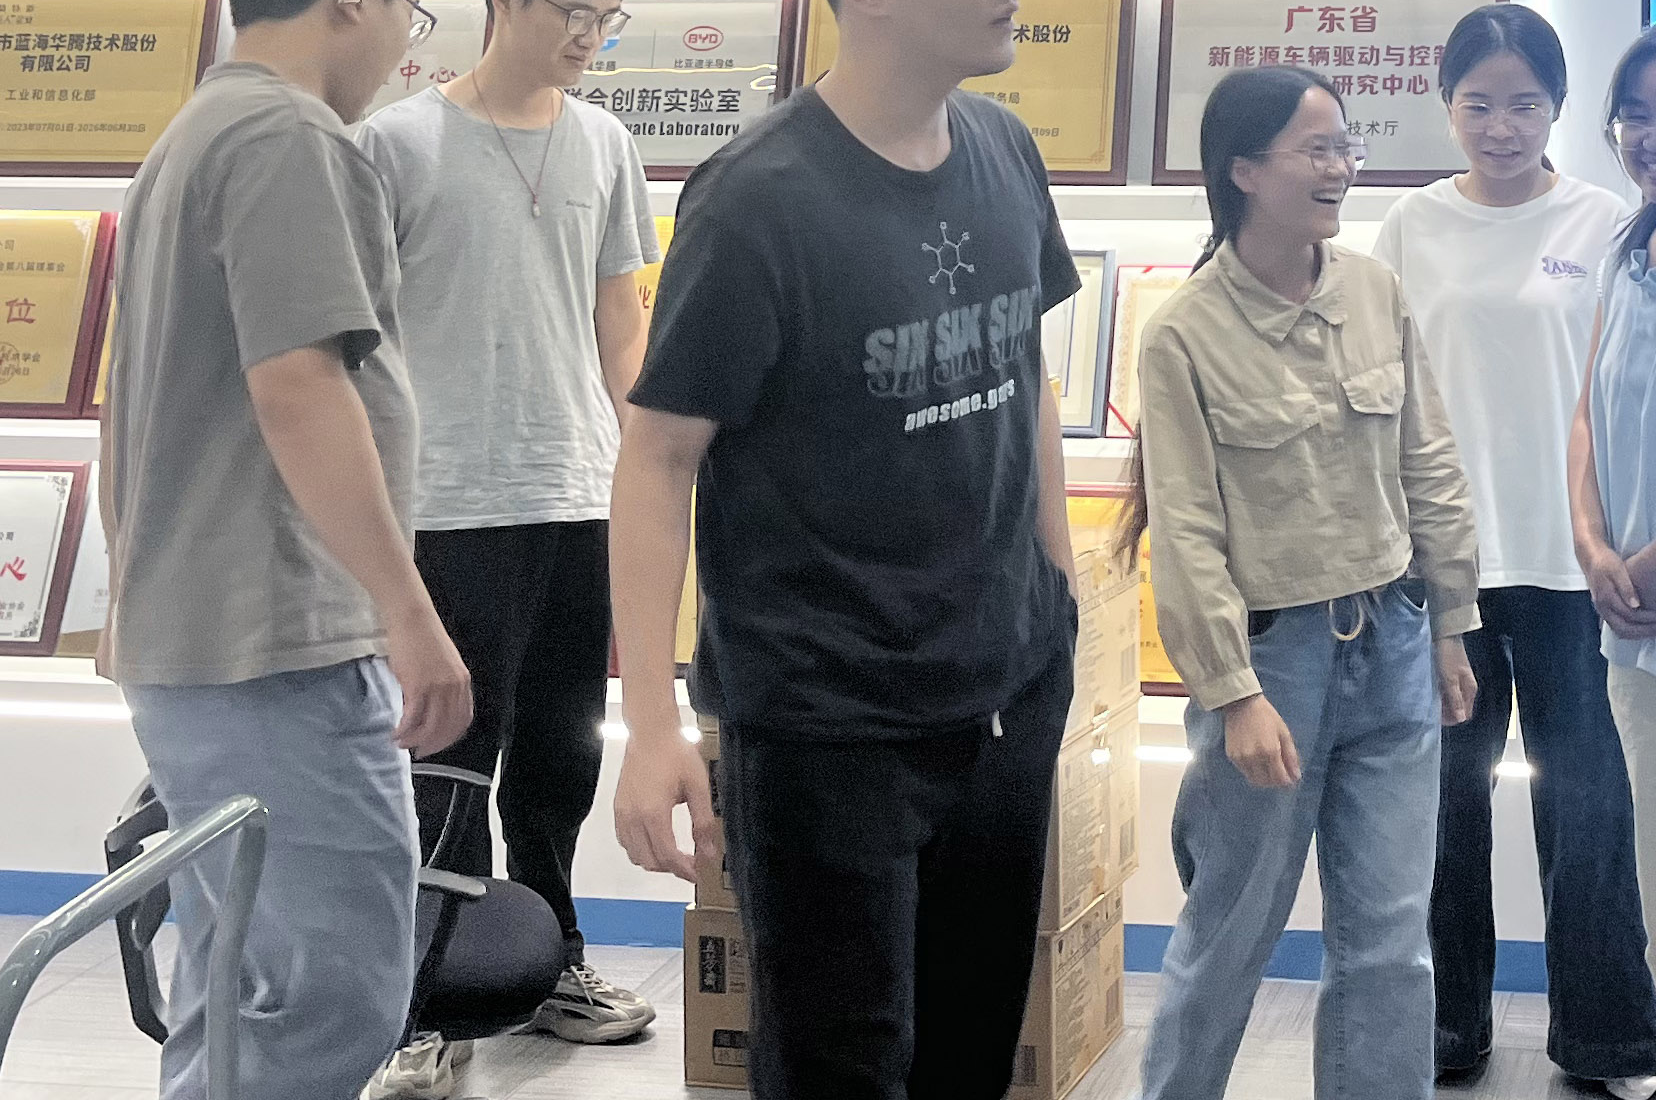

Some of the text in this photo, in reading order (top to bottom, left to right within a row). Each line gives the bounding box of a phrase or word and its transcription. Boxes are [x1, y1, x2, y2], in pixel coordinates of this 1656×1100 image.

[1284, 5, 1379, 34] 广东省
[688, 33, 719, 44] BYD
[1012, 23, 1072, 44] 术股份
[20, 53, 92, 73] 有限公司
[5, 88, 97, 102] 工业和信息化部
[659, 121, 741, 137] Laboratory
[5, 297, 37, 324] 位
